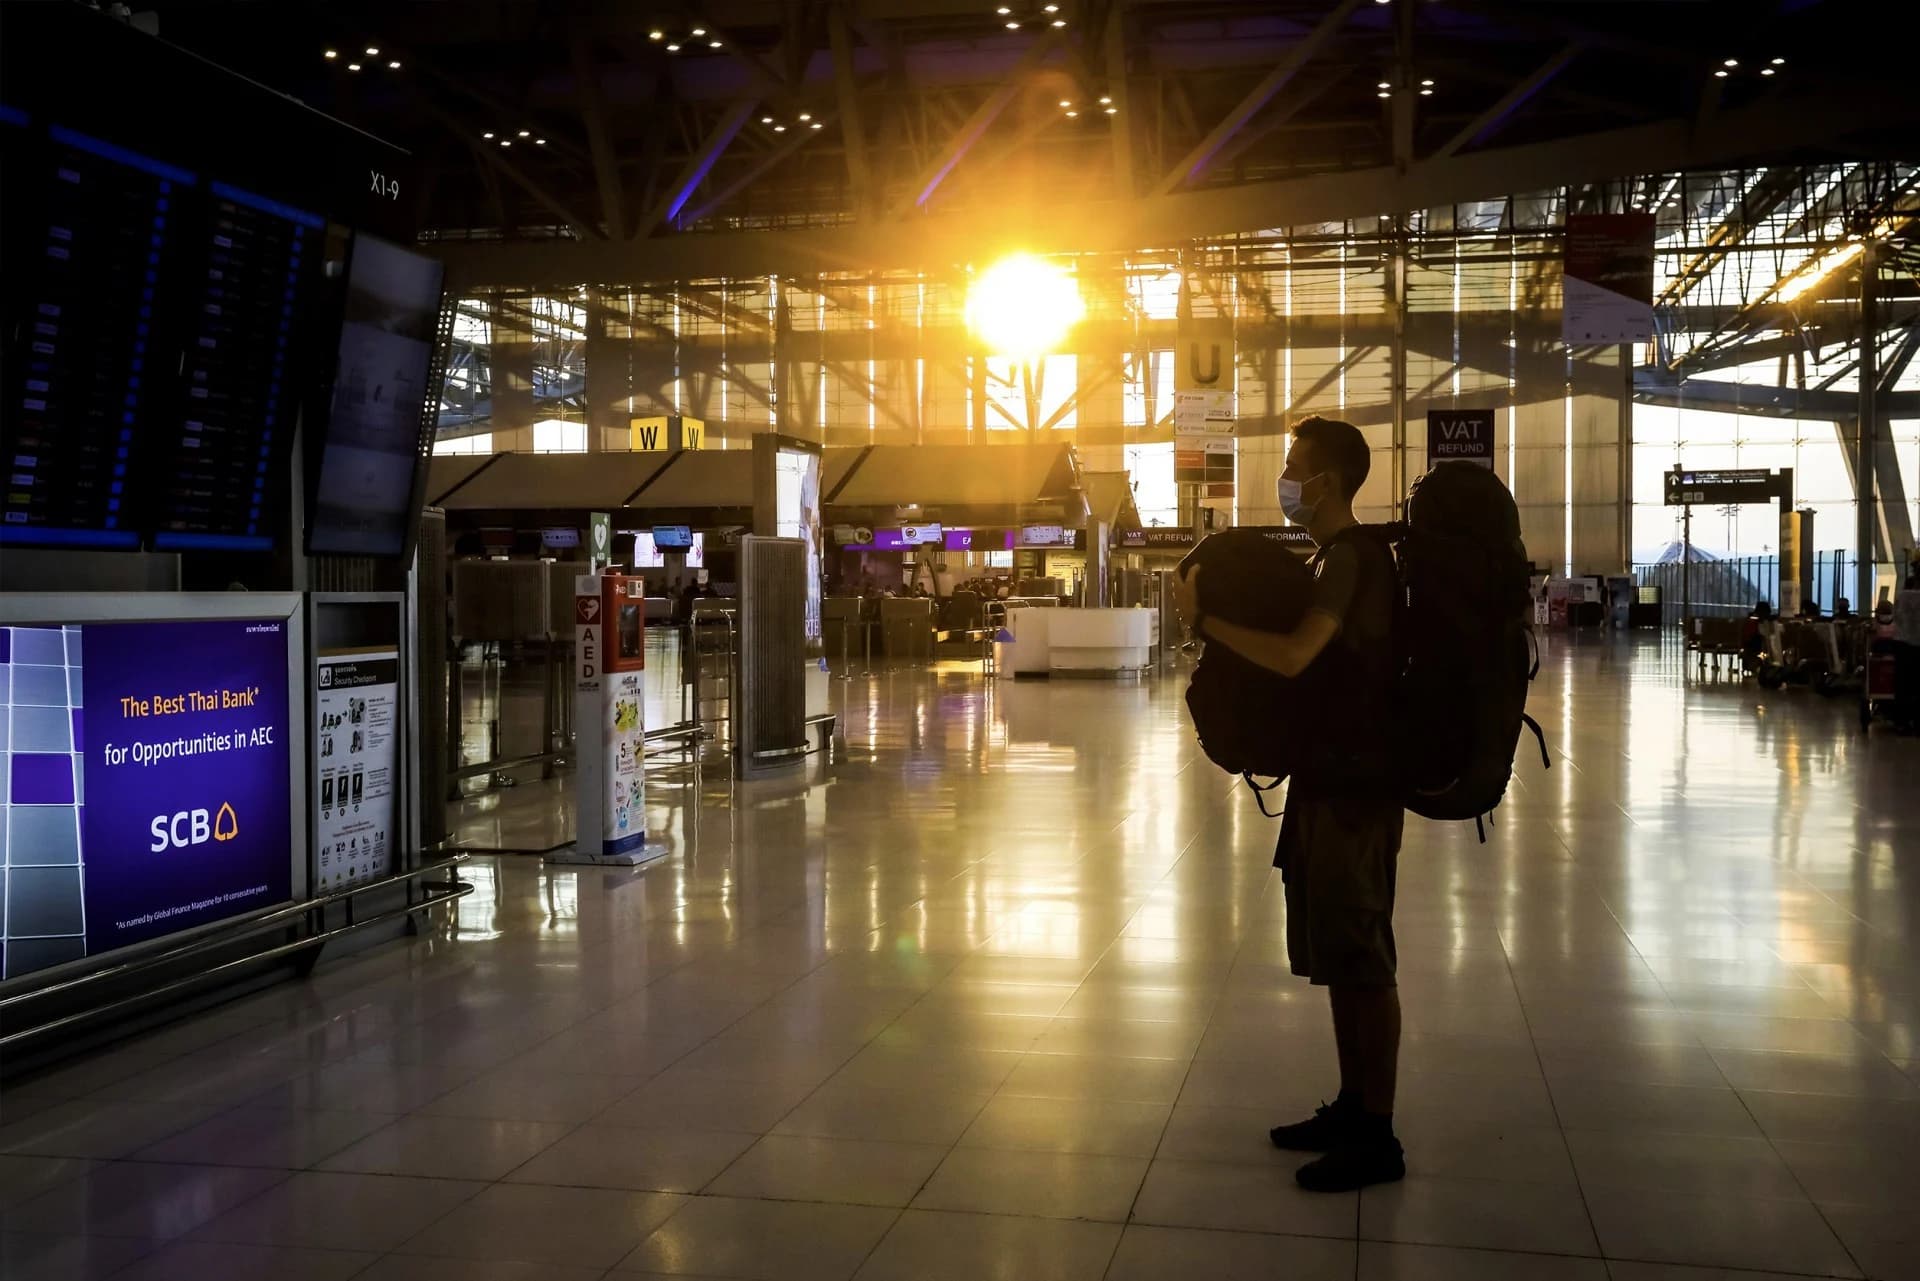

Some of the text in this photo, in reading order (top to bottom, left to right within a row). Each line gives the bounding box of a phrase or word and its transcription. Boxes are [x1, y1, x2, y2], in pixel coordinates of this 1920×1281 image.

[370, 169, 399, 200] X1-9
[1190, 344, 1220, 384] U
[640, 426, 658, 450] W
[688, 427, 699, 450] W
[1440, 420, 1483, 439] VAT
[1437, 442, 1485, 454] REFUND
[1148, 533, 1193, 541] VAT REFUN
[120, 696, 149, 718] The
[153, 694, 185, 715] Best
[188, 689, 218, 712] Thai
[105, 726, 274, 767] for Opportunities in AEC
[151, 808, 210, 852] SCB
[127, 914, 146, 927] named
[146, 913, 153, 924] by
[154, 908, 171, 920] Global
[172, 904, 191, 916] Finance
[191, 898, 214, 911] Magazine
